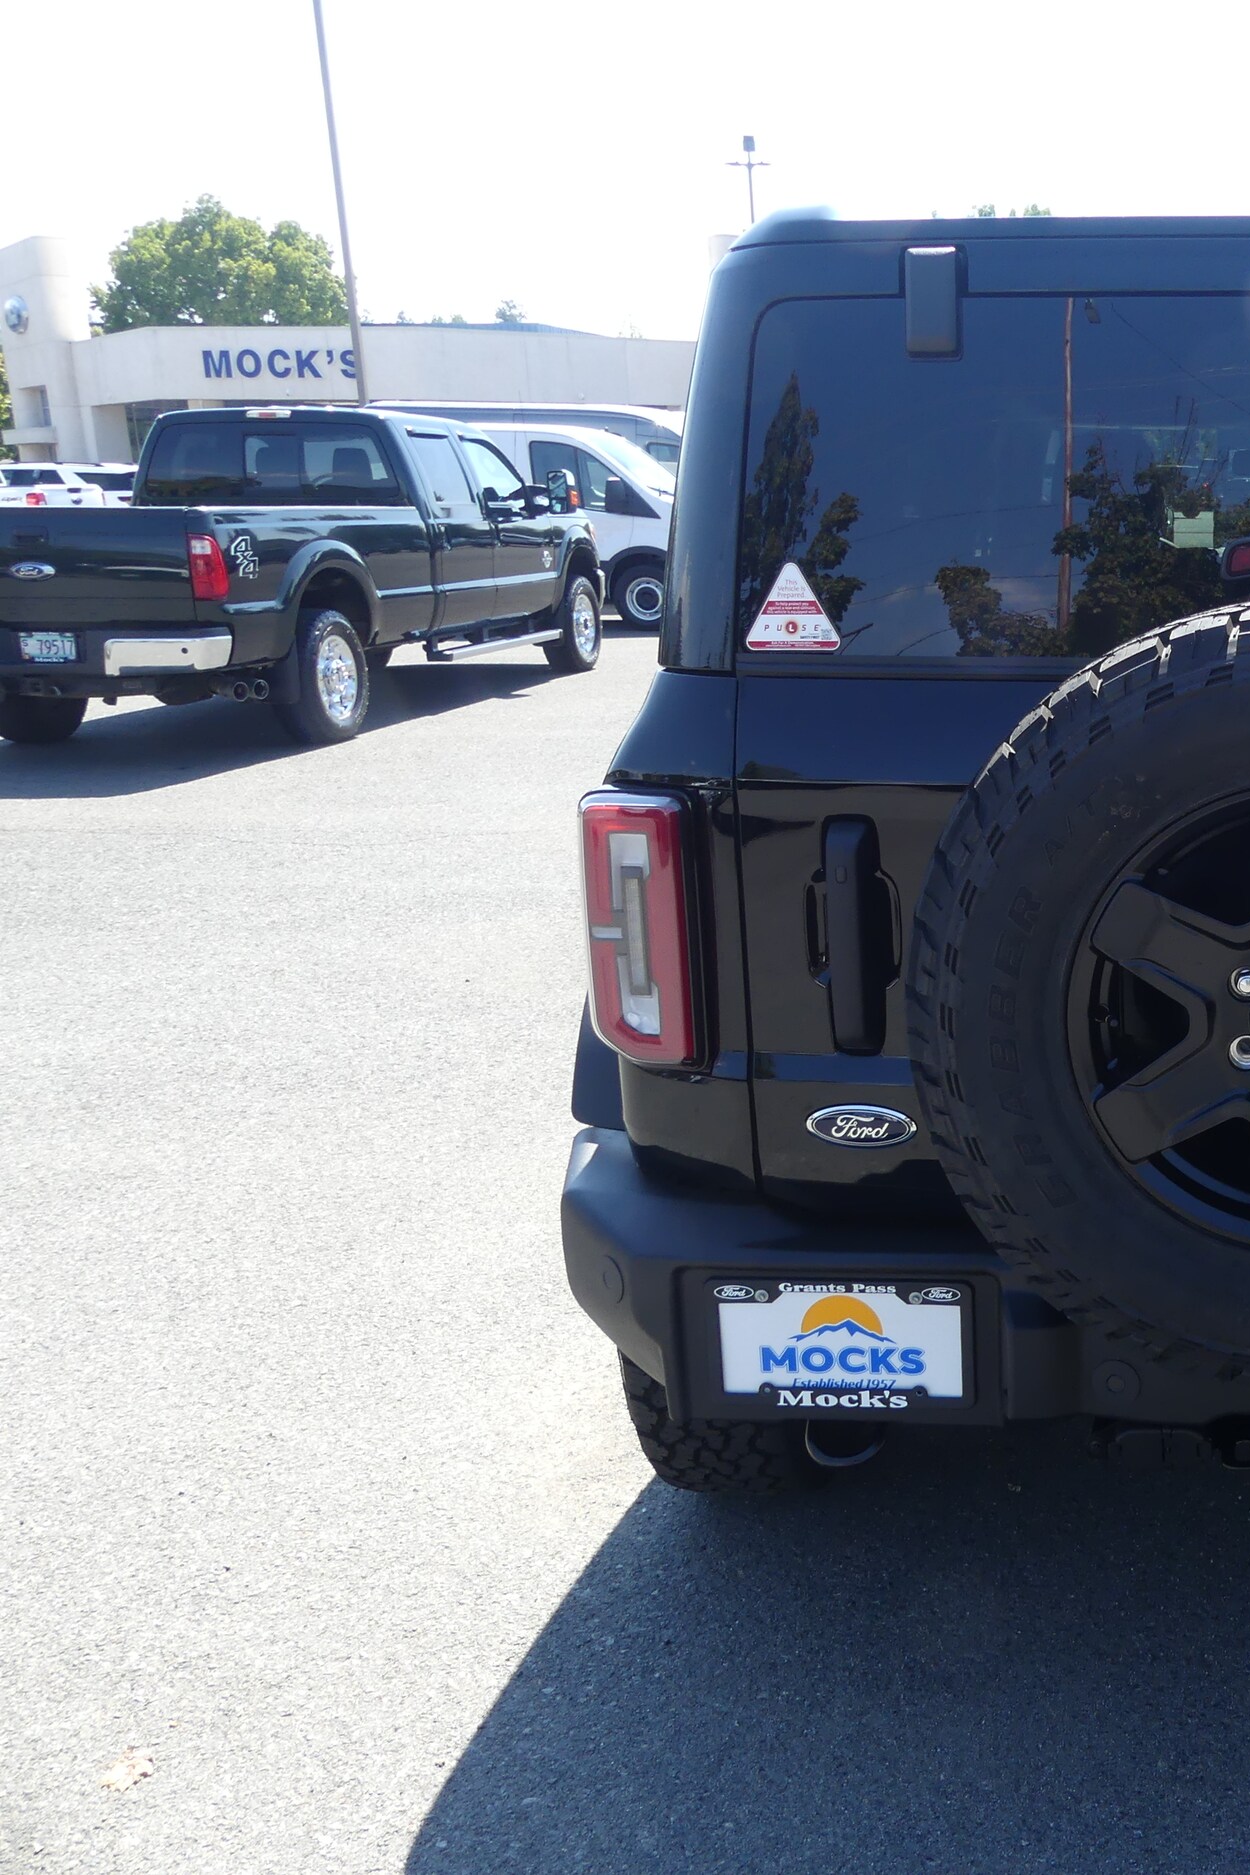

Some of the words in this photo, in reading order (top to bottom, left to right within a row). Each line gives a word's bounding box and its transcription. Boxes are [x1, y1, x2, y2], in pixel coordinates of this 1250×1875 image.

[202, 349, 357, 379] MOCK'S
[831, 1114, 889, 1139] Ford
[721, 1286, 747, 1297] Ford
[778, 1282, 846, 1293] Grants
[852, 1283, 896, 1294] Pass
[928, 1289, 953, 1299] Ford
[759, 1345, 926, 1376] MOCKS
[792, 1378, 864, 1389] Established
[866, 1379, 896, 1389] 1957
[777, 1390, 908, 1408] Mock's
